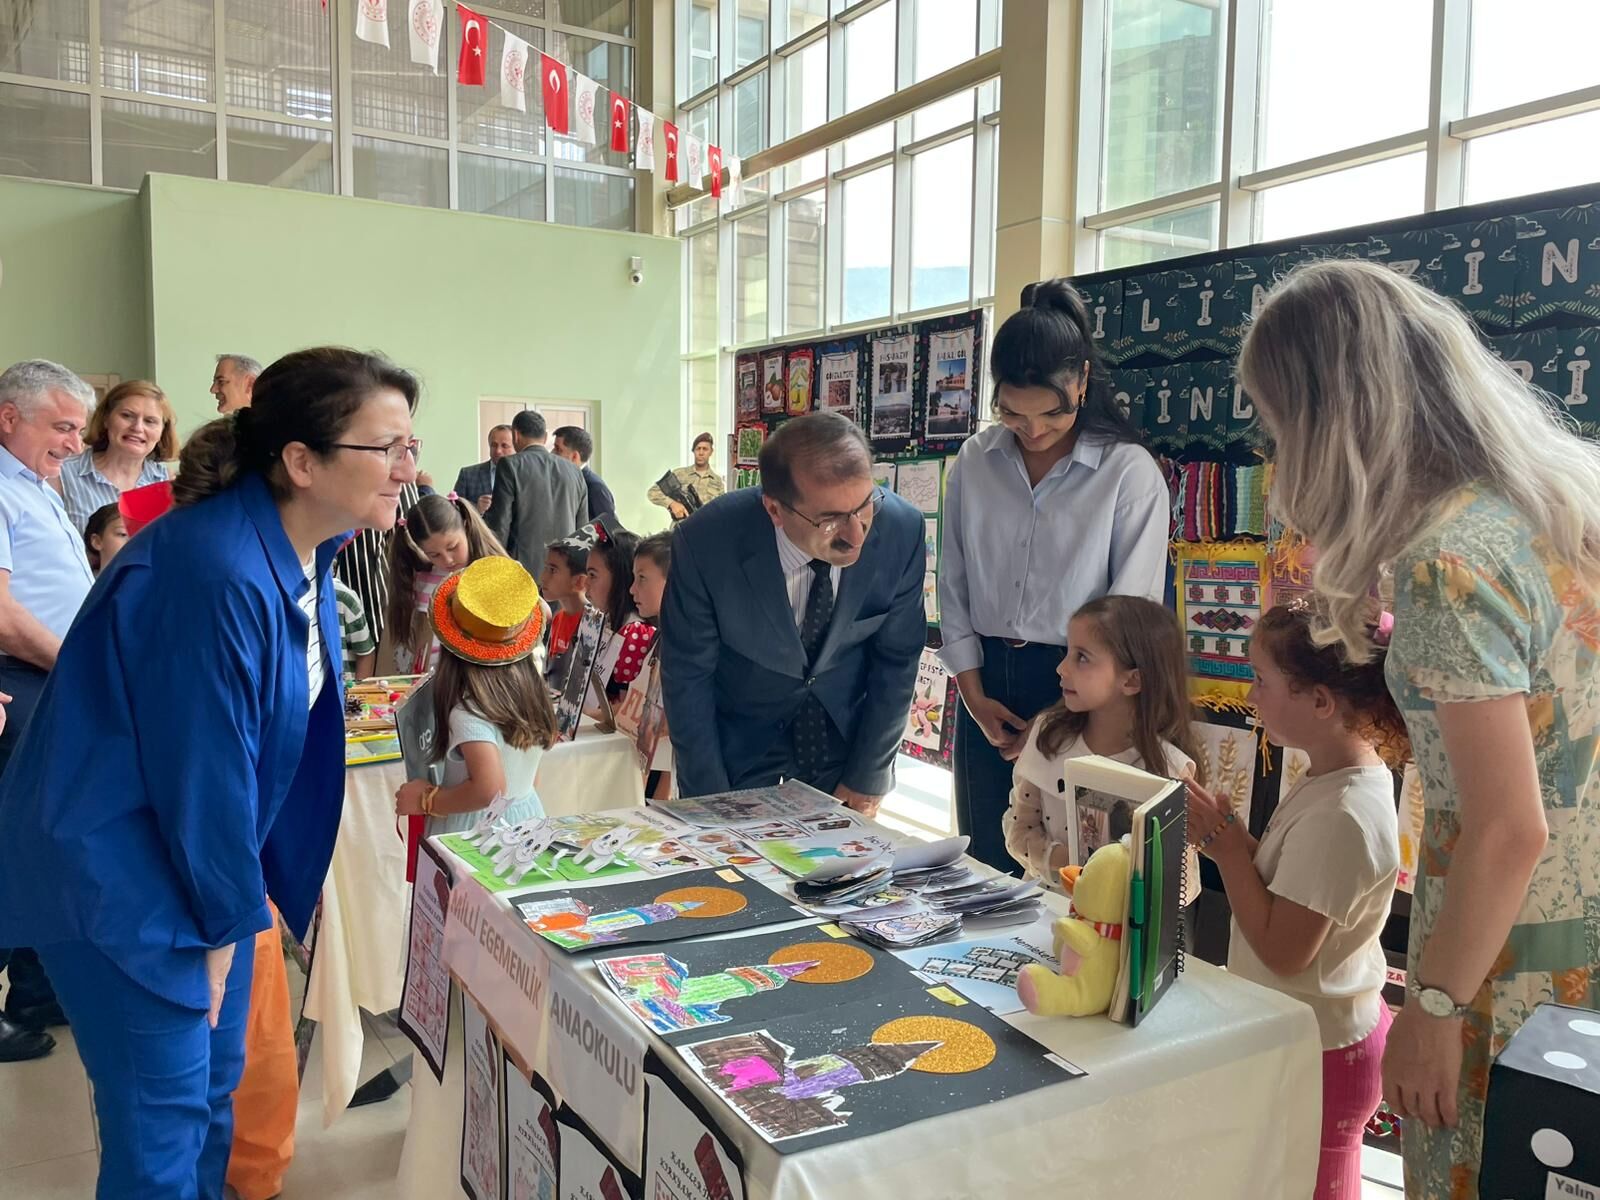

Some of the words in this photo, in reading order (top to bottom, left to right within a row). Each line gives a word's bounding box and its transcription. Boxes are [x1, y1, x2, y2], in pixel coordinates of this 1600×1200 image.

[451, 889, 480, 937] MİLLİ
[480, 918, 542, 1011] EGEMENLİK
[550, 991, 636, 1097] ANAOKULU
[1555, 1177, 1594, 1200] Yalın
